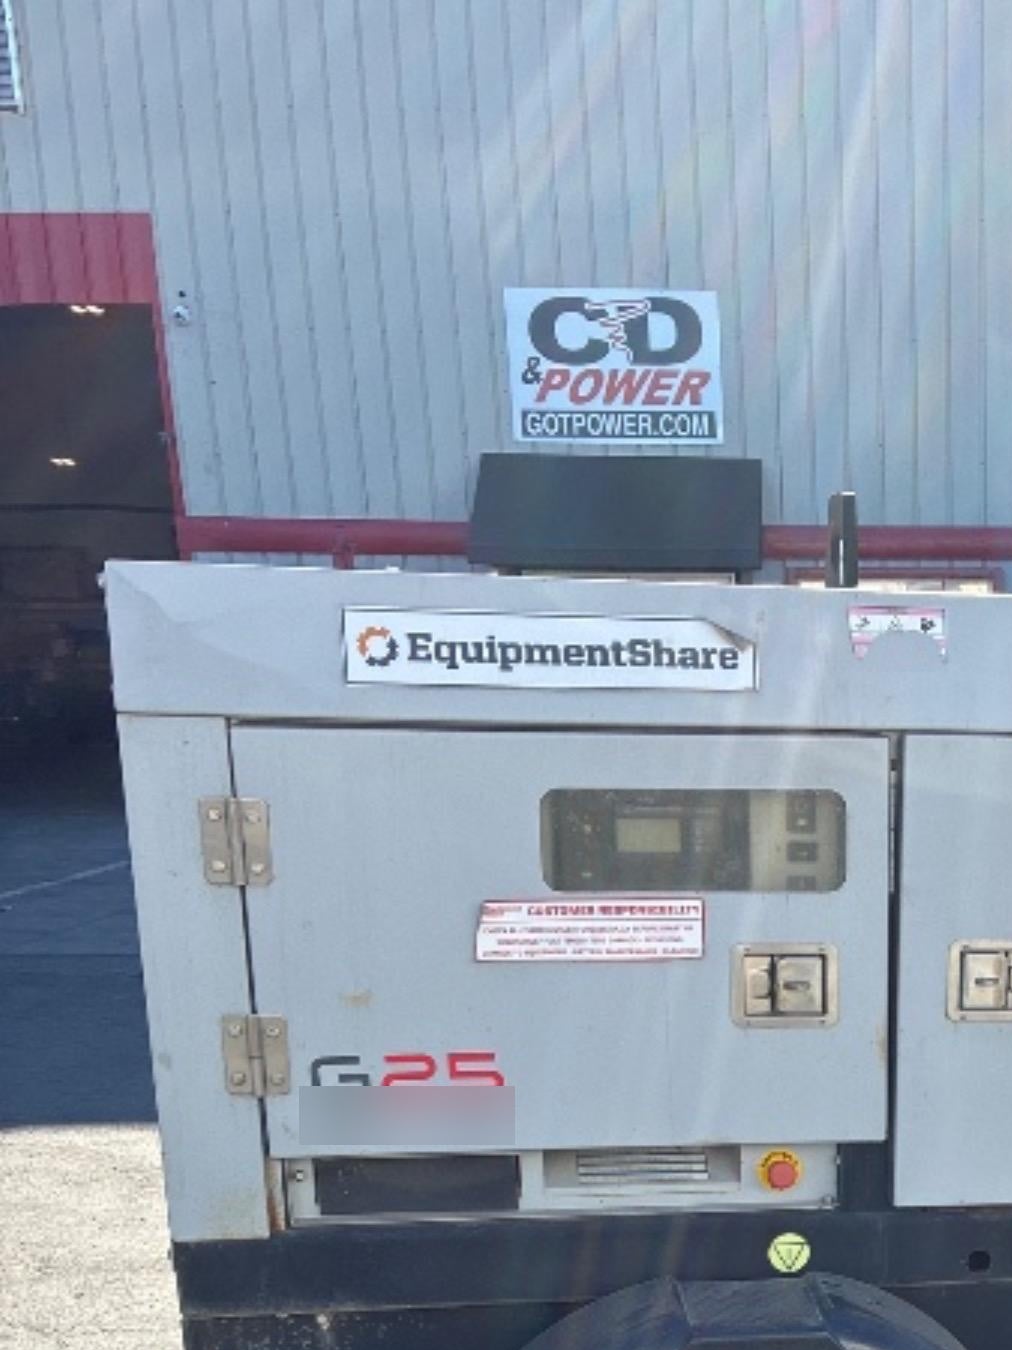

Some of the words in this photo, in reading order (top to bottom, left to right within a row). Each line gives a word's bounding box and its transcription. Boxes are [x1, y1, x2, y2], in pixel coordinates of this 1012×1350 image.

[534, 368, 711, 406] POWER
[526, 411, 709, 436] GOTPOWER.COM
[406, 631, 739, 672] EquipmentShare
